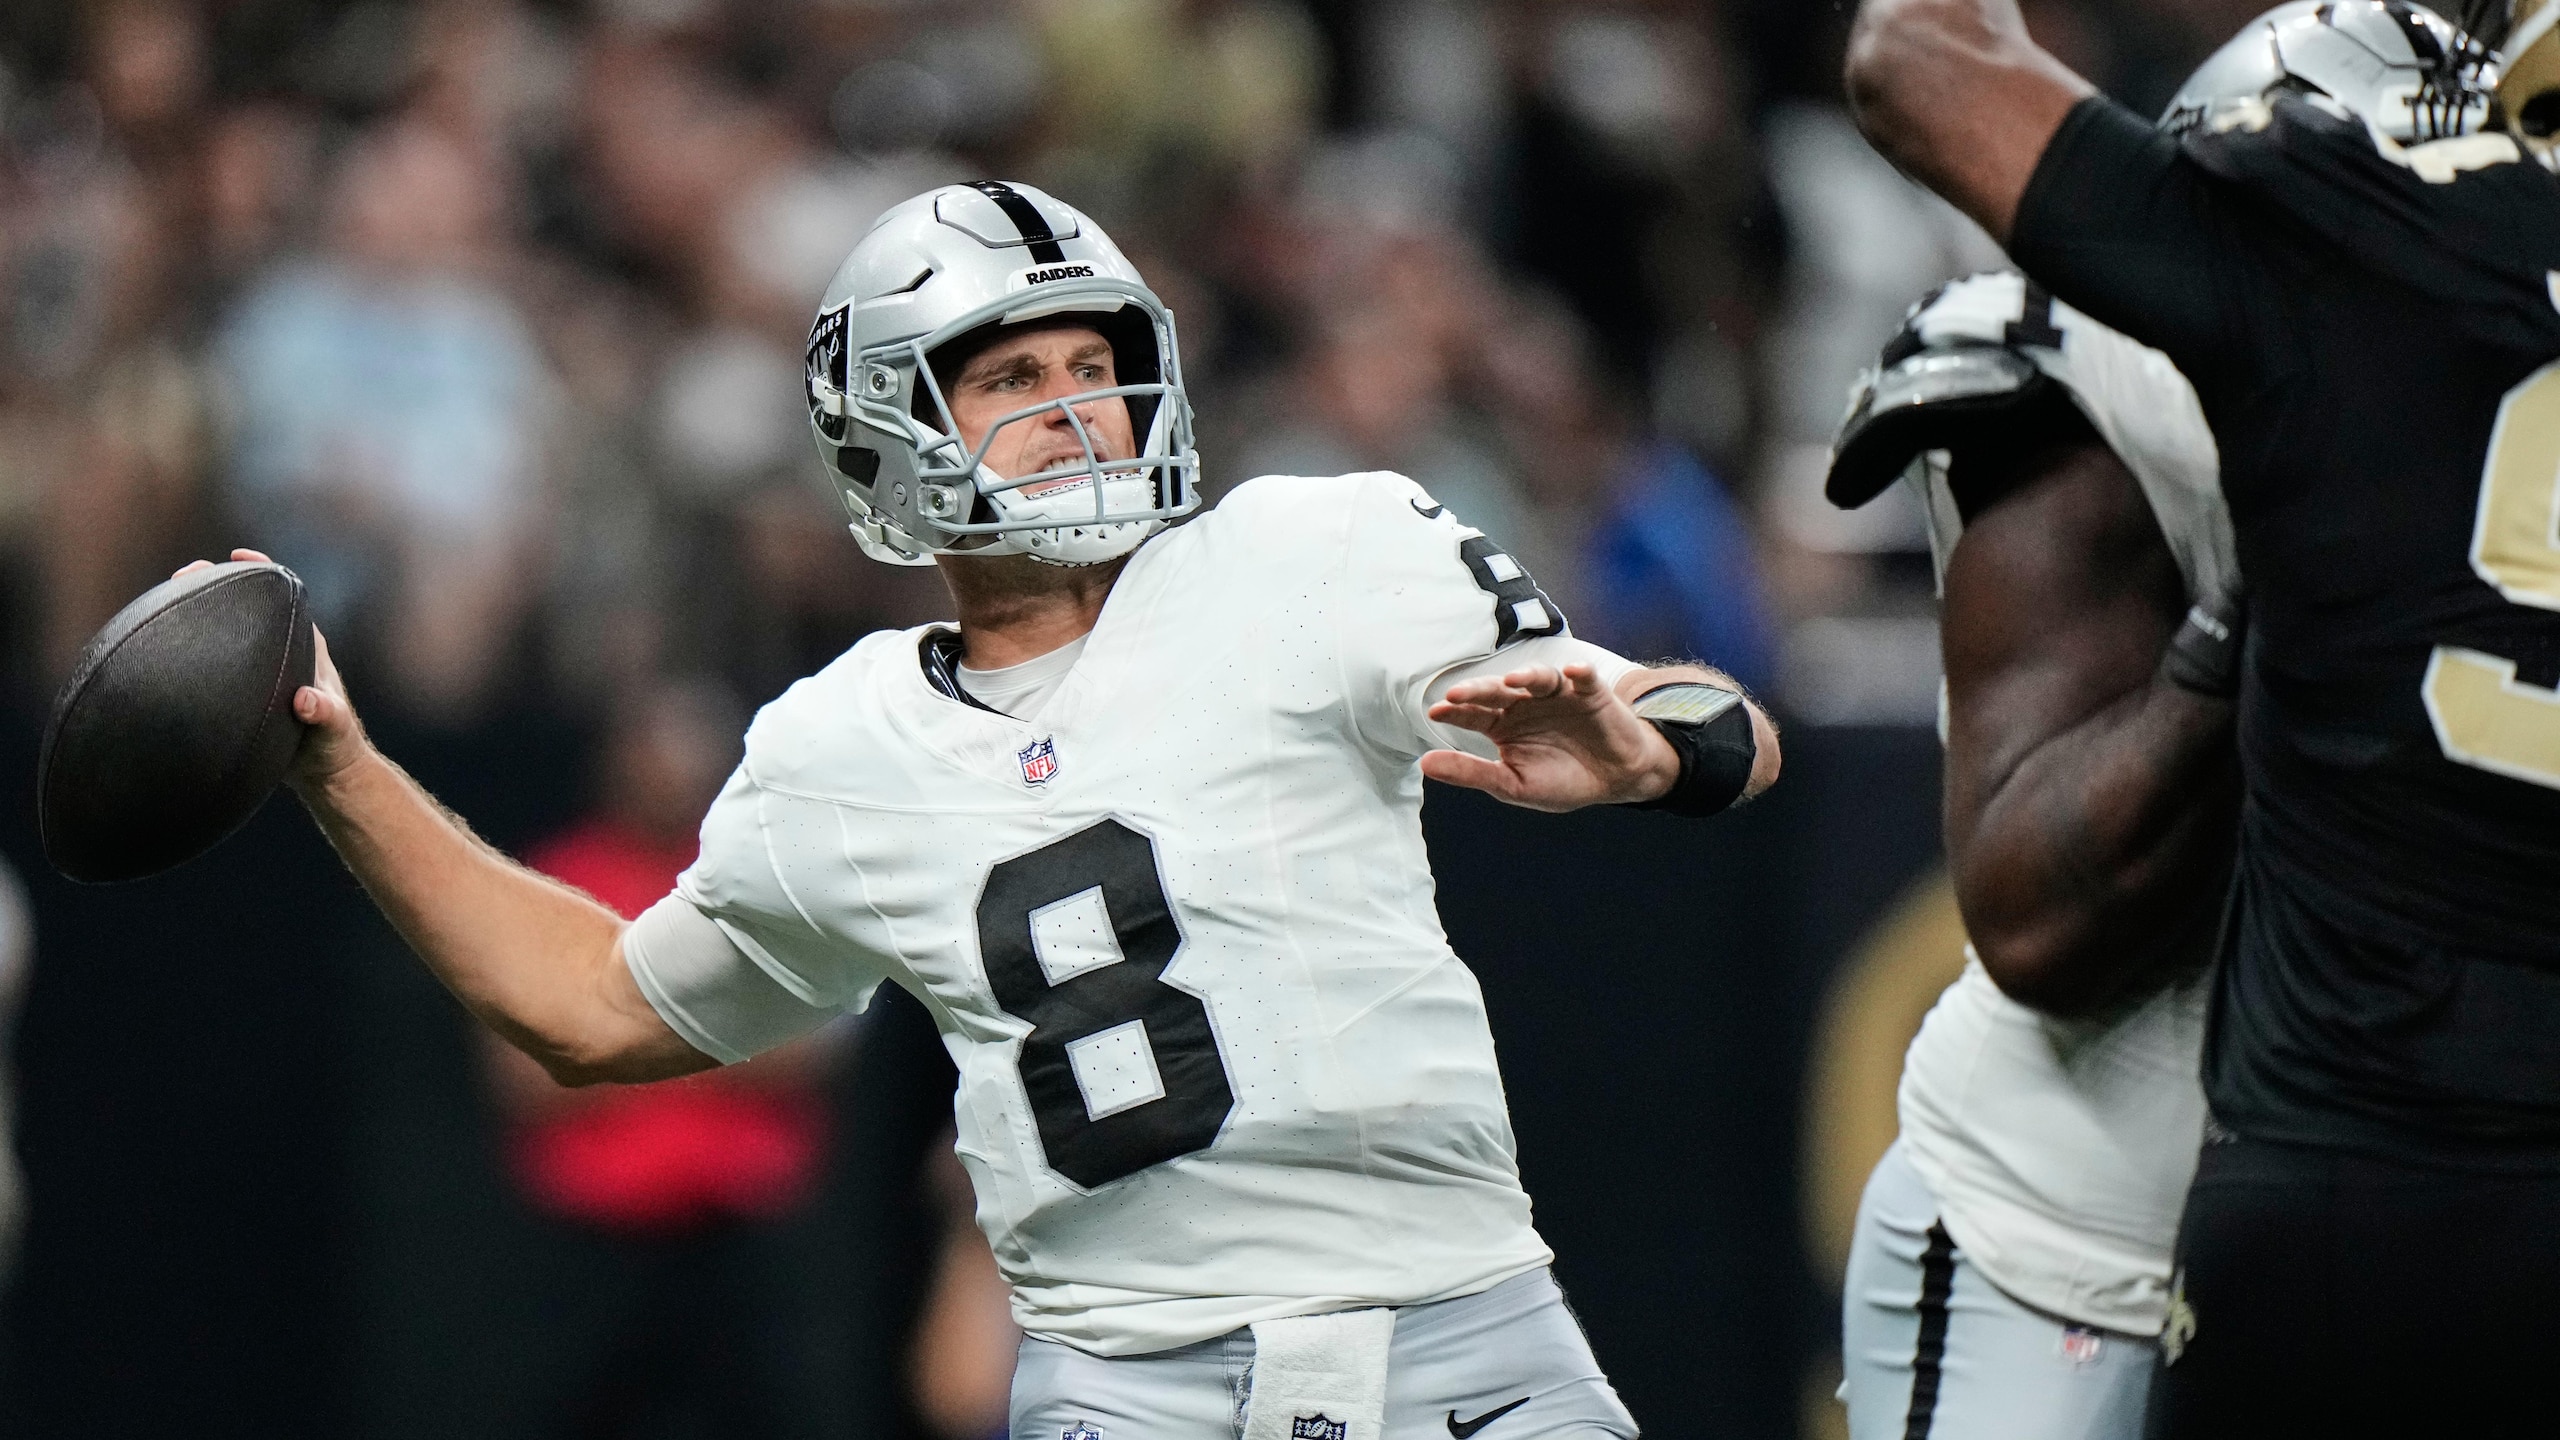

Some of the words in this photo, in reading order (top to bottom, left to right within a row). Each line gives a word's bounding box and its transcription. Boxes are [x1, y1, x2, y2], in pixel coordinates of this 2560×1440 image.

[1025, 265, 1094, 285] RAIDERS
[1457, 533, 1566, 652] 8
[1025, 755, 1054, 780] NFL
[973, 815, 1240, 1192] 8
